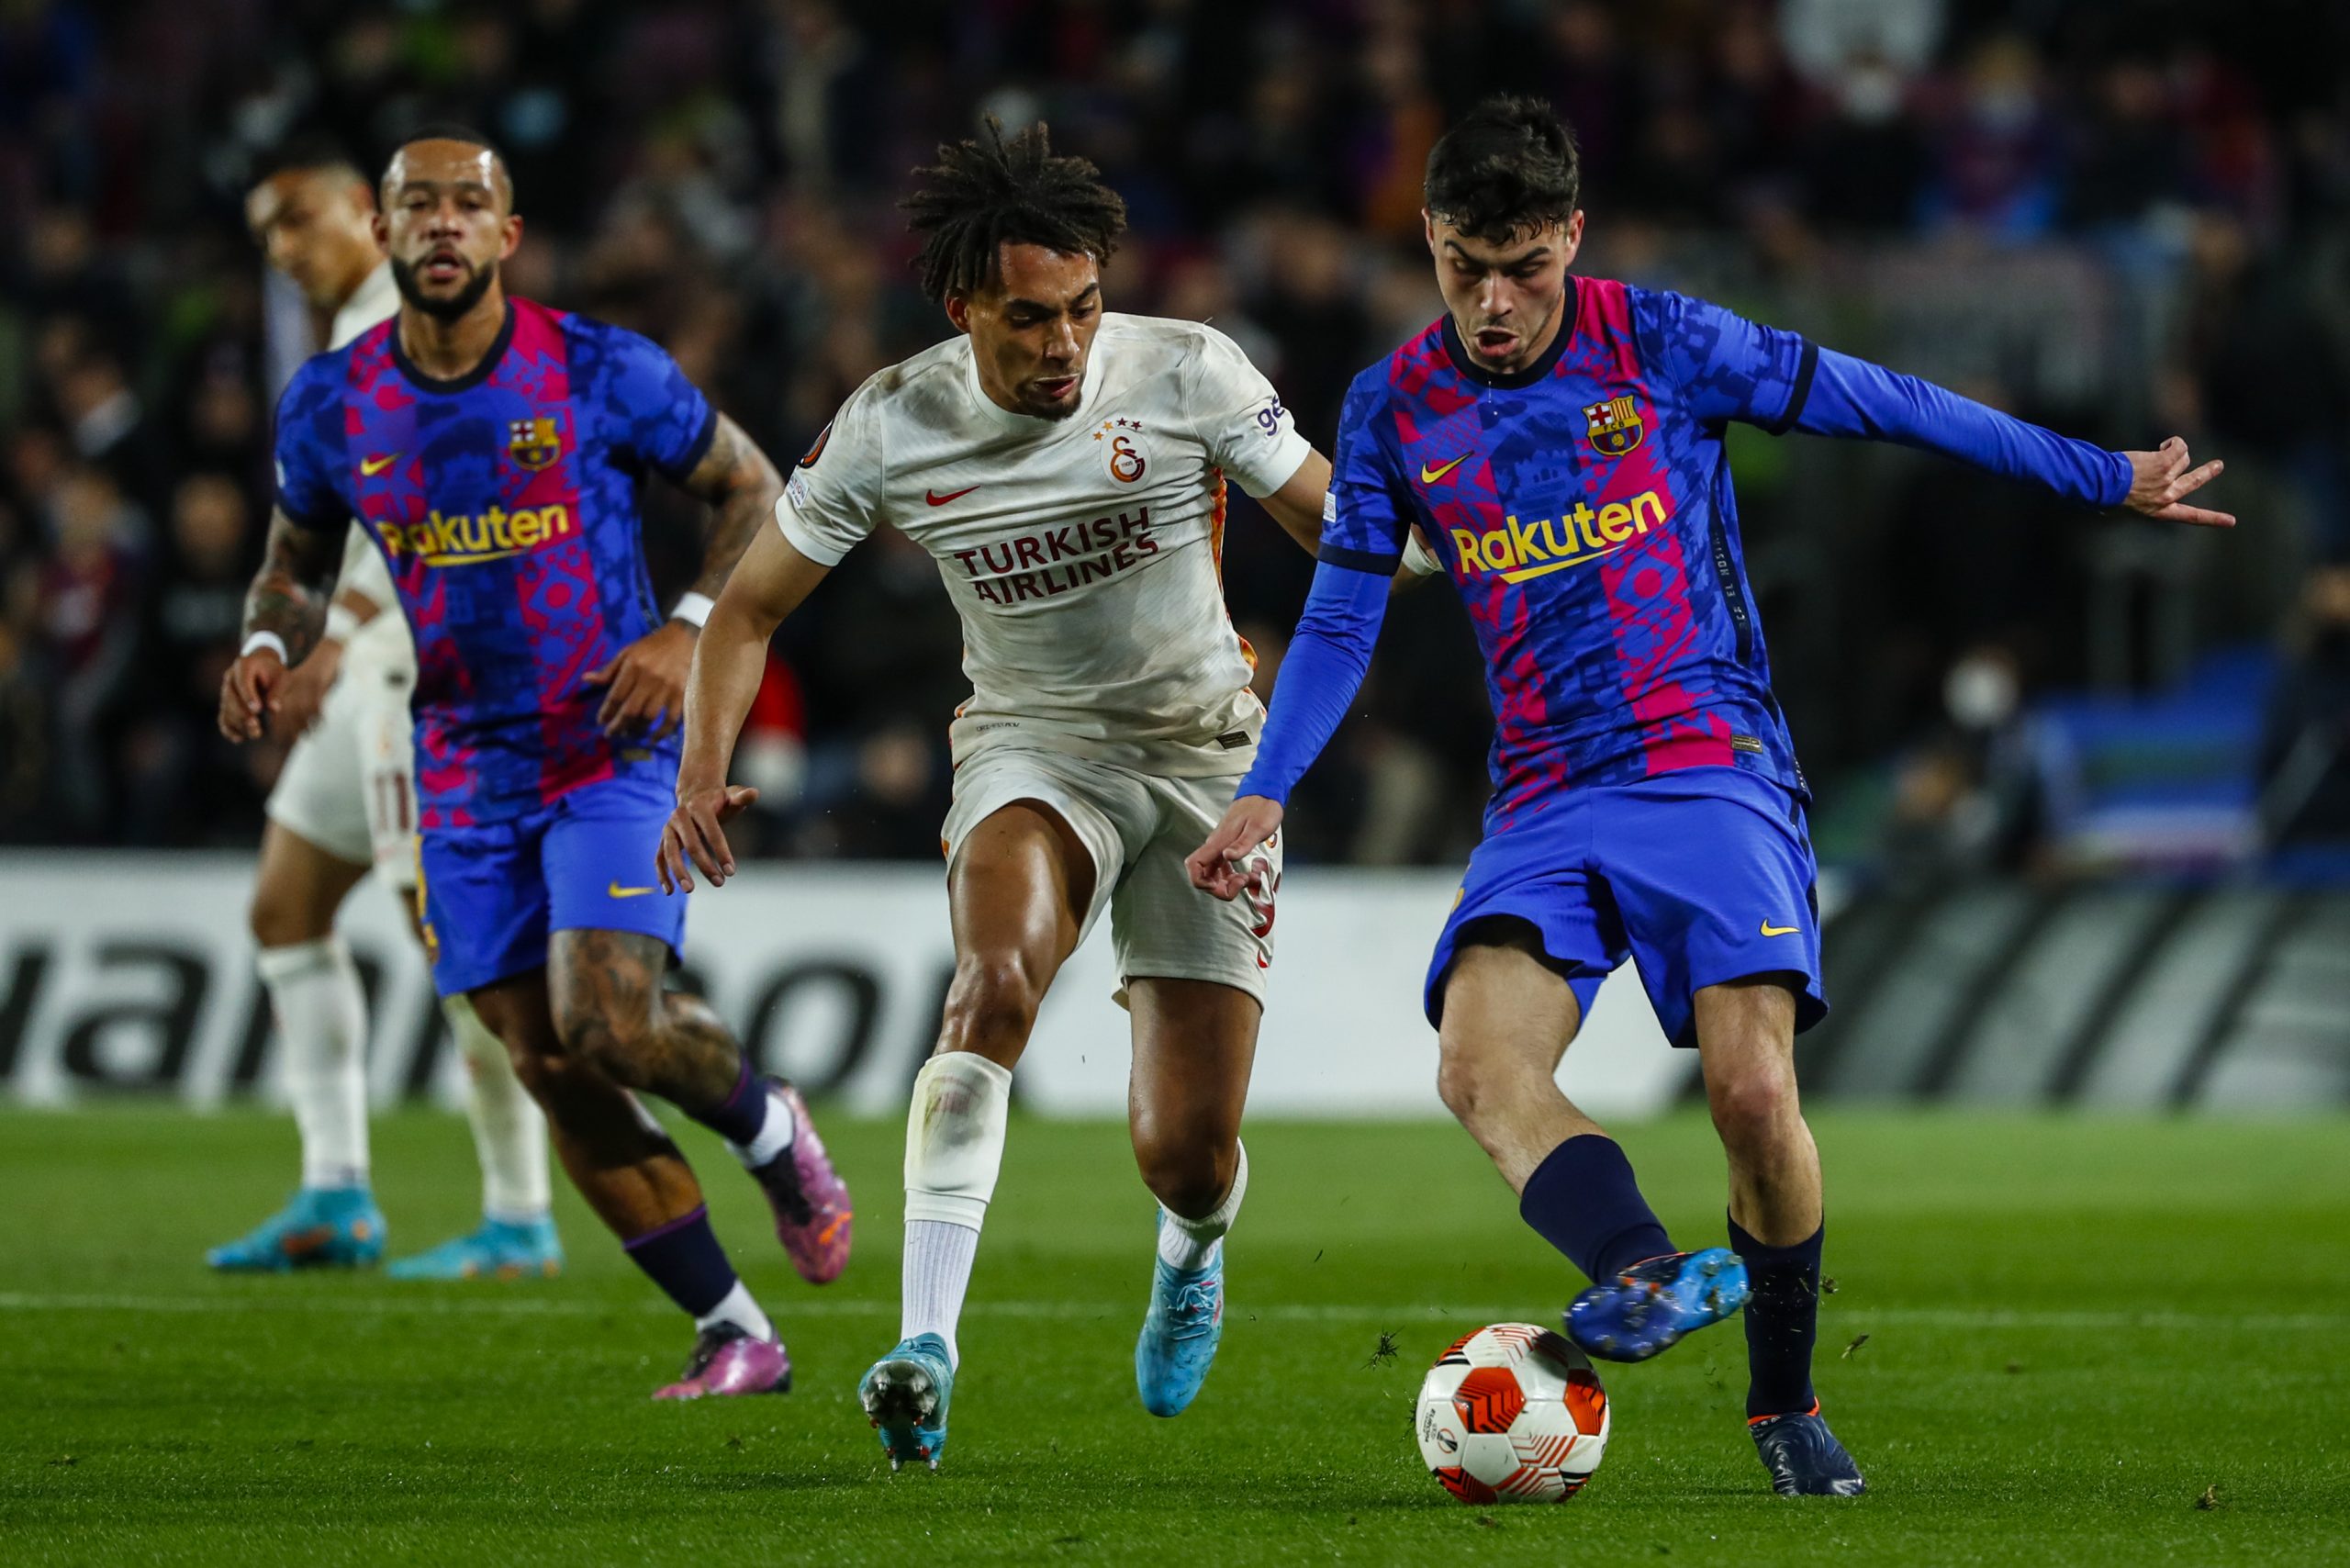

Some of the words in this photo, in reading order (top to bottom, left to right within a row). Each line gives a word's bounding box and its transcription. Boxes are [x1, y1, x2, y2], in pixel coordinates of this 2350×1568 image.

[955, 506, 1150, 577] TURKISH
[968, 532, 1158, 605] AIRLINES
[1450, 490, 1667, 574] Rakuten
